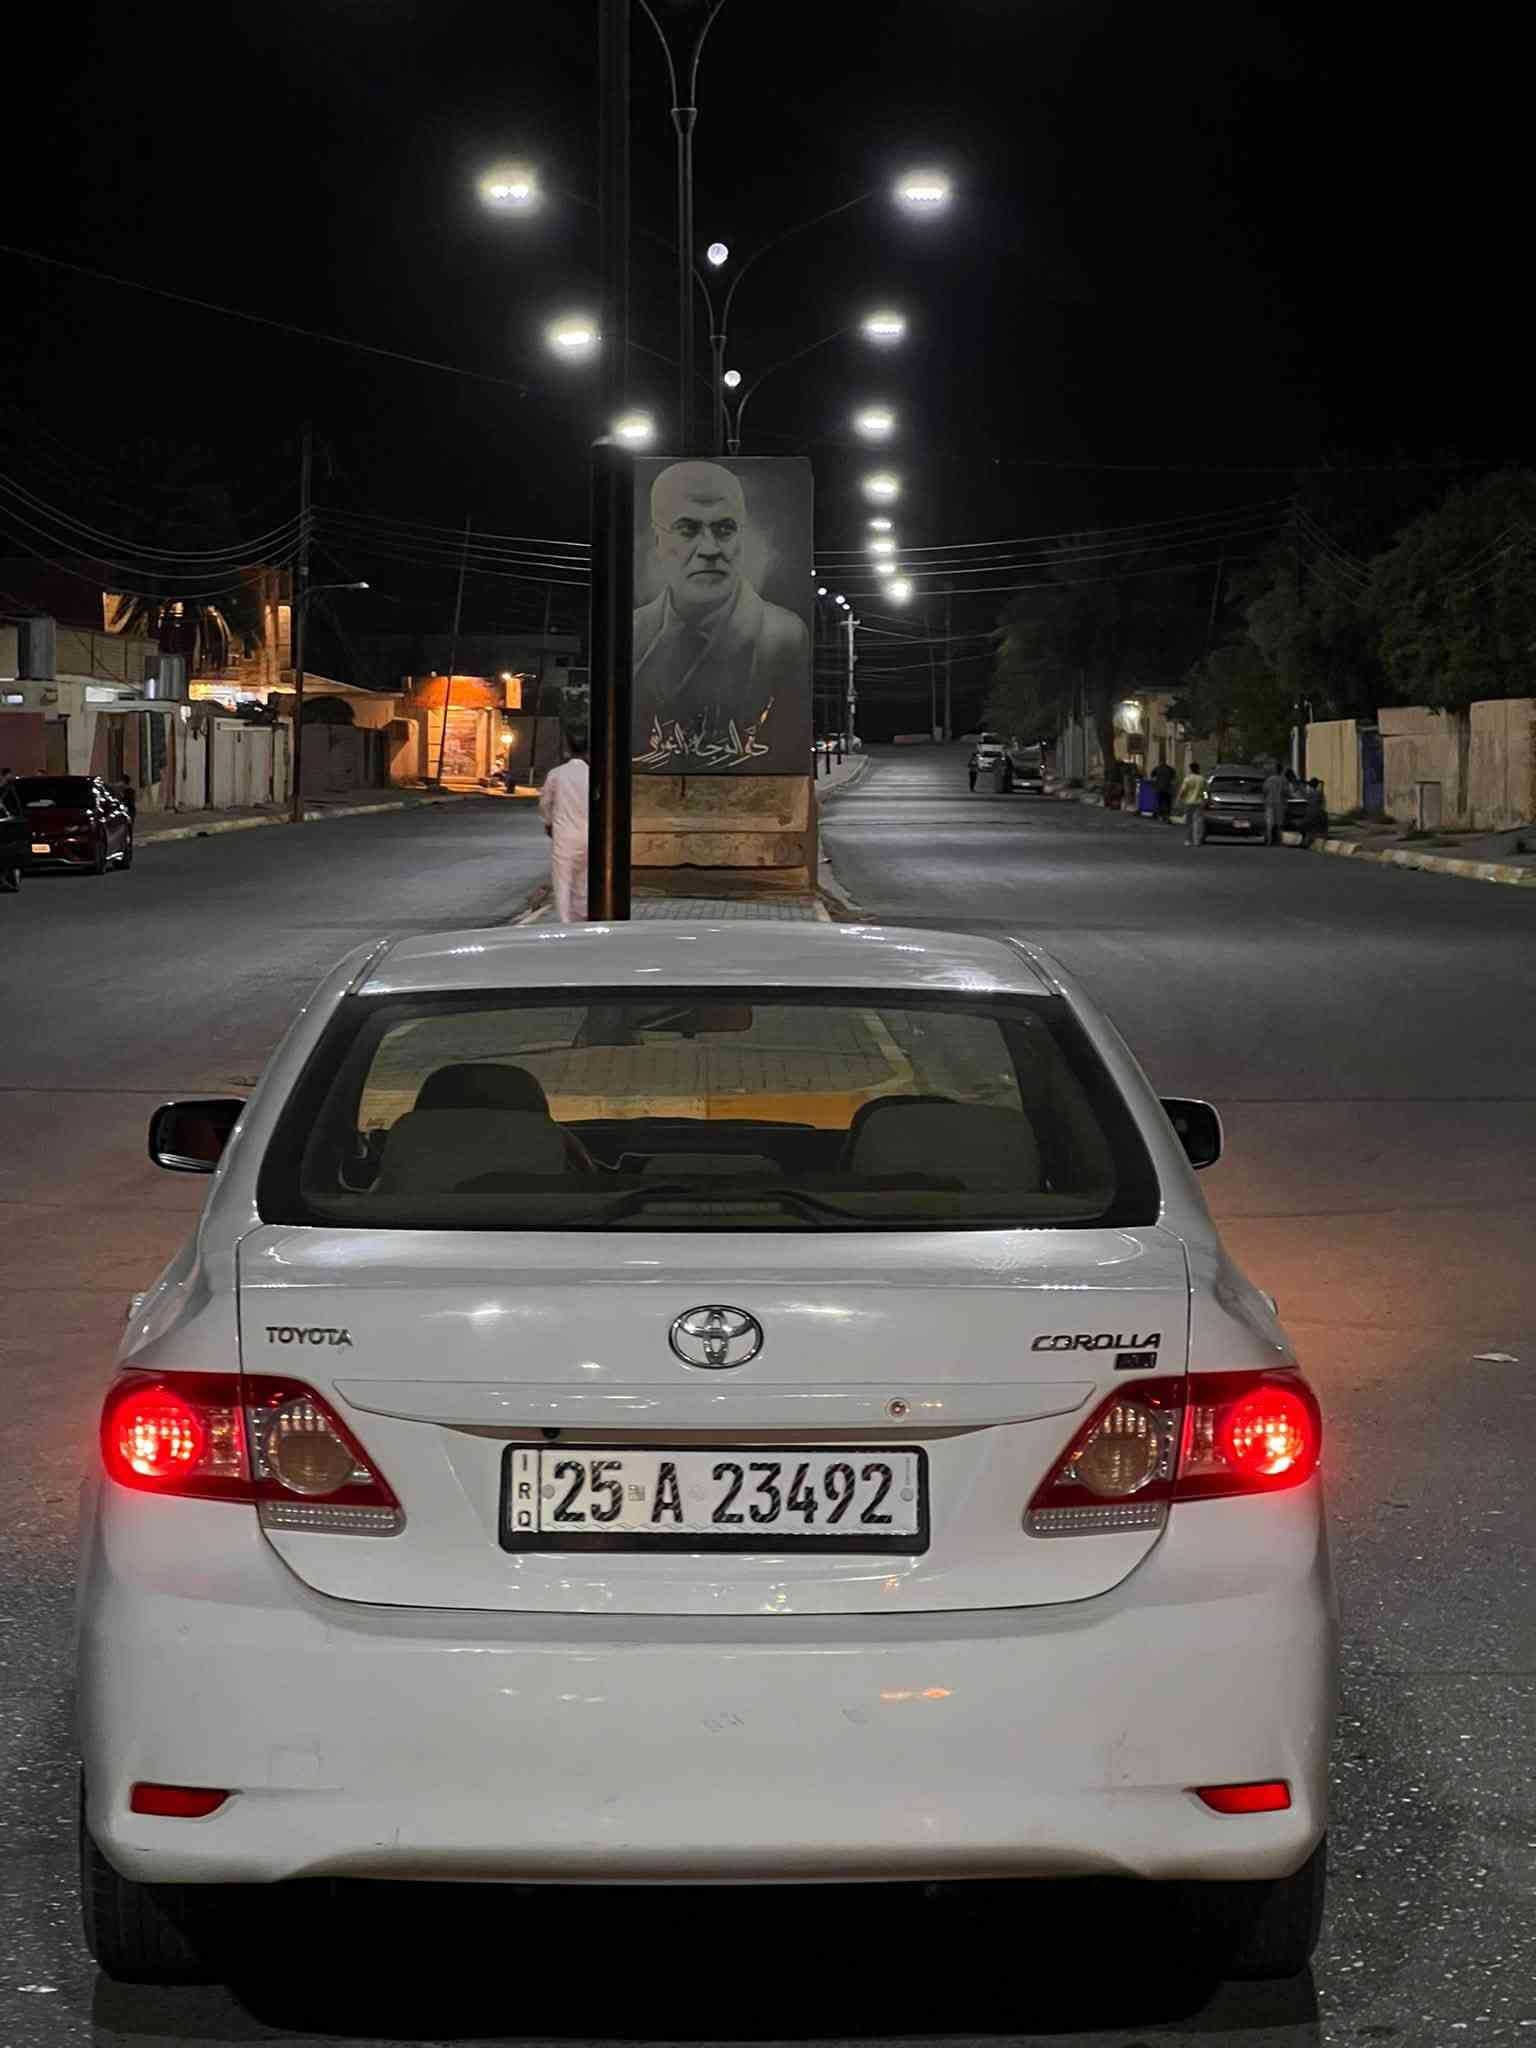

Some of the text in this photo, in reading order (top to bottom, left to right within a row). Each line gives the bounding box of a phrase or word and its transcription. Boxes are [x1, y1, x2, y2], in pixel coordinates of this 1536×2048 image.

[265, 1326, 353, 1346] TOYOTA
[1031, 1333, 1161, 1351] COROLLA
[553, 1461, 622, 1522] 25
[651, 1462, 683, 1523] A
[712, 1463, 893, 1523] 23492
